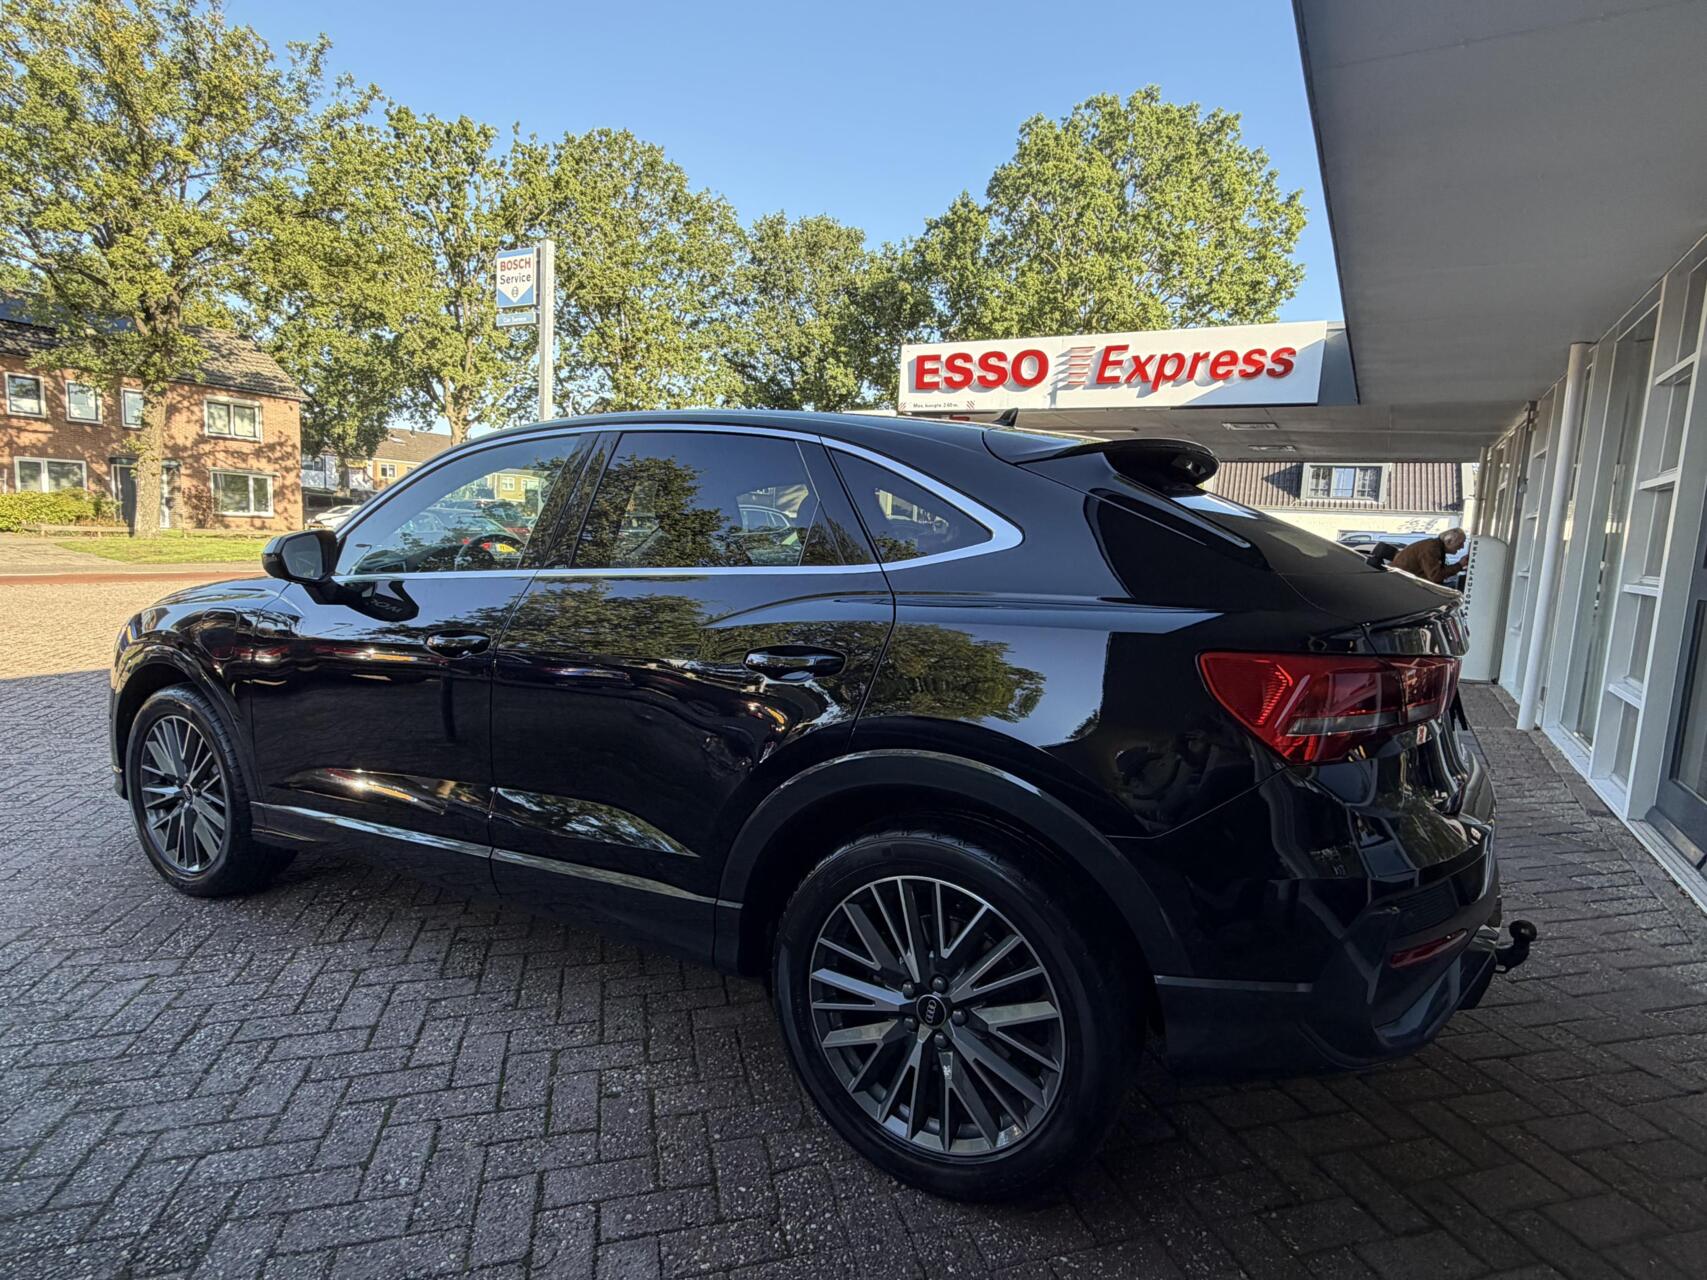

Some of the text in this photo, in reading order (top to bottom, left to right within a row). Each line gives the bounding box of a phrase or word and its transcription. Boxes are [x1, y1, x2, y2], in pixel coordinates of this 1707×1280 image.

[500, 257, 531, 272] BOSCH
[500, 273, 531, 285] Service
[915, 344, 1297, 392] ESSO Express
